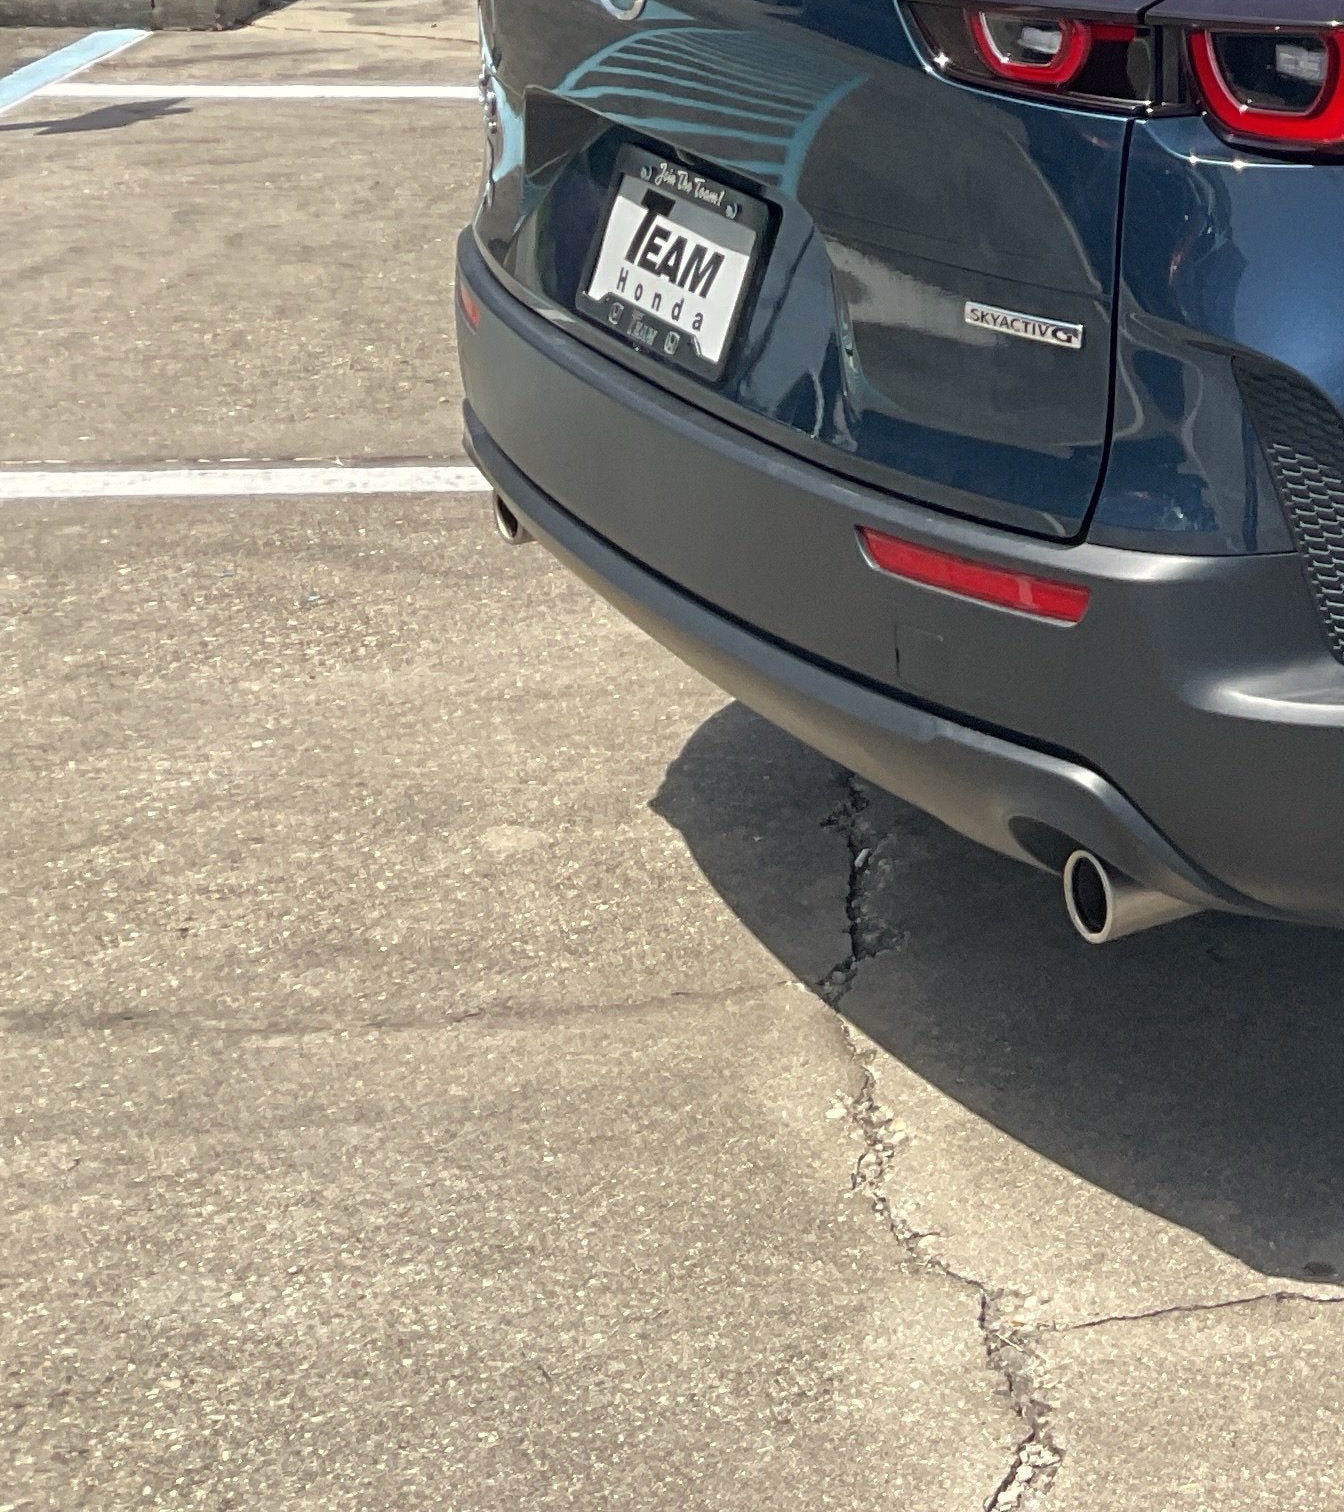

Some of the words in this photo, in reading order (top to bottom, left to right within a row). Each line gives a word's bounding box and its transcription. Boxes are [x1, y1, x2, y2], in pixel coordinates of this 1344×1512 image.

[654, 162, 677, 186] Join
[624, 188, 726, 299] TEAM
[616, 266, 704, 331] Honda
